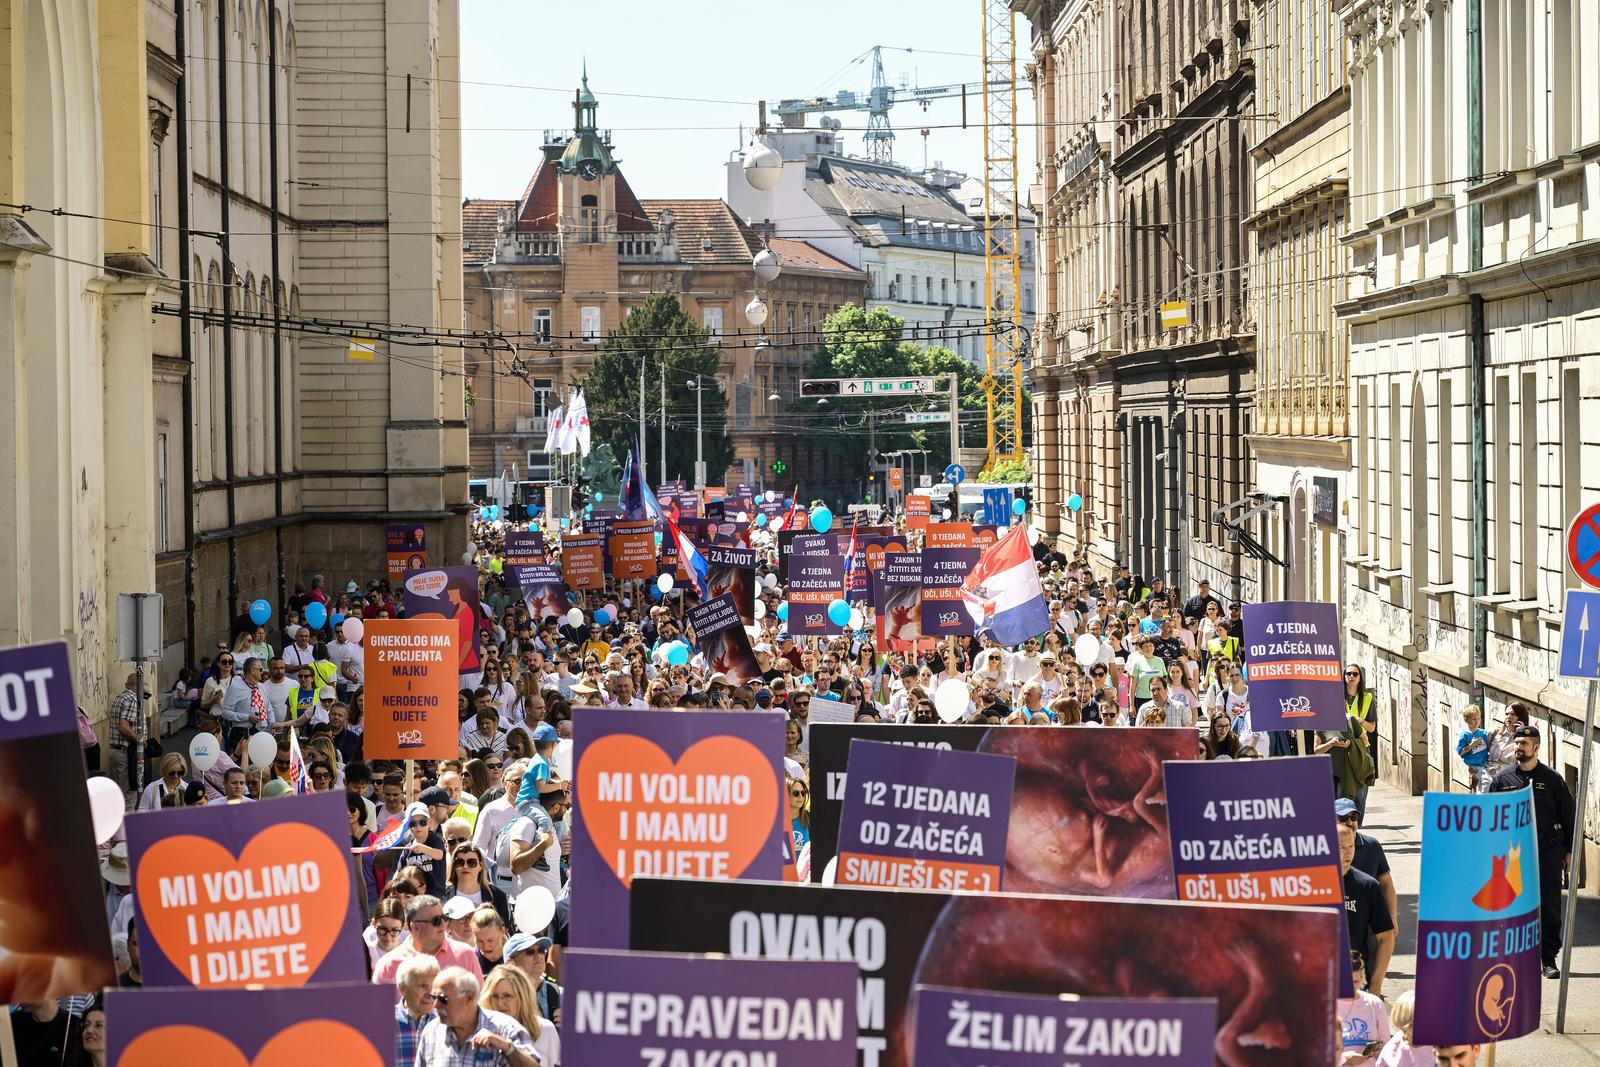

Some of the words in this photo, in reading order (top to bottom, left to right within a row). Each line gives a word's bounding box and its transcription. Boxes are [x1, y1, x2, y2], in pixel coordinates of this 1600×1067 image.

[804, 539, 826, 548] SVAKO
[711, 551, 722, 562] ZA
[724, 549, 752, 565] ŽIVOT
[894, 556, 915, 564] ZAKON
[940, 561, 967, 569] TJEDNA
[807, 567, 832, 575] TJEDNA
[889, 565, 910, 573] ŠTITITI
[910, 565, 922, 573] SVE
[801, 579, 827, 588] ZAČEĆA
[924, 576, 933, 584] OD
[934, 574, 962, 584] ZAČEĆA
[693, 605, 709, 619] ZAKON
[708, 599, 726, 612] TREBA
[693, 615, 709, 629] ŠTITITI
[708, 611, 719, 623] SVE
[717, 605, 735, 619] LJUDE
[696, 629, 706, 638] BEZ
[1266, 623, 1274, 634] 4
[1276, 622, 1318, 635] TJEDNA
[370, 635, 428, 647] GINEKOLOG
[430, 635, 451, 647] IMA
[1250, 645, 1266, 656] OD
[1268, 641, 1312, 656] ZAČEĆA
[1314, 644, 1335, 656] IMA
[378, 650, 385, 661] 2
[387, 650, 442, 662] PACIJENTA
[392, 665, 428, 676] MAJKU
[1251, 663, 1292, 677] OTISKE
[1294, 664, 1338, 677] PRSTIJU
[408, 681, 411, 691] I
[382, 695, 438, 707] NEROĐENO
[1279, 696, 1310, 709] HOD
[393, 711, 427, 721] DIJETE
[397, 729, 422, 740] HOD
[597, 771, 633, 803] MI
[639, 772, 751, 805] VOLIMO
[862, 781, 888, 806] 12
[892, 783, 991, 818] TJEDANA
[1203, 800, 1218, 822] 4
[1220, 797, 1296, 821] TJEDNA
[1436, 803, 1482, 832] OVO
[1489, 803, 1511, 832] JE
[619, 810, 628, 841] I
[636, 811, 728, 843] MAMU
[860, 819, 890, 846] OD
[894, 821, 984, 856] ZAČEĆA
[1179, 840, 1206, 861] OD
[1209, 833, 1287, 861] ZAČEĆA
[1290, 834, 1330, 857] IMA
[617, 848, 626, 879] I
[633, 849, 730, 879] DIJETE
[844, 857, 933, 891] SMIJEŠI
[939, 867, 968, 892] SE
[159, 873, 198, 909] MI
[202, 860, 321, 904] VOLIMO
[1184, 874, 1223, 901] OČI,
[1226, 873, 1266, 901] UŠI,
[1270, 875, 1333, 898] NOS...
[187, 914, 198, 945] I
[204, 903, 301, 944] MAMU
[728, 909, 887, 972] OVAKO
[1426, 931, 1472, 960] OVO
[1477, 930, 1500, 959] JE
[1504, 918, 1540, 957] DIJETE
[190, 954, 200, 985] I
[206, 943, 309, 983] DIJETE
[574, 990, 844, 1041] NEPRAVEDAN
[945, 999, 1058, 1055] ŽELIM
[1063, 1017, 1183, 1056] ZAKON
